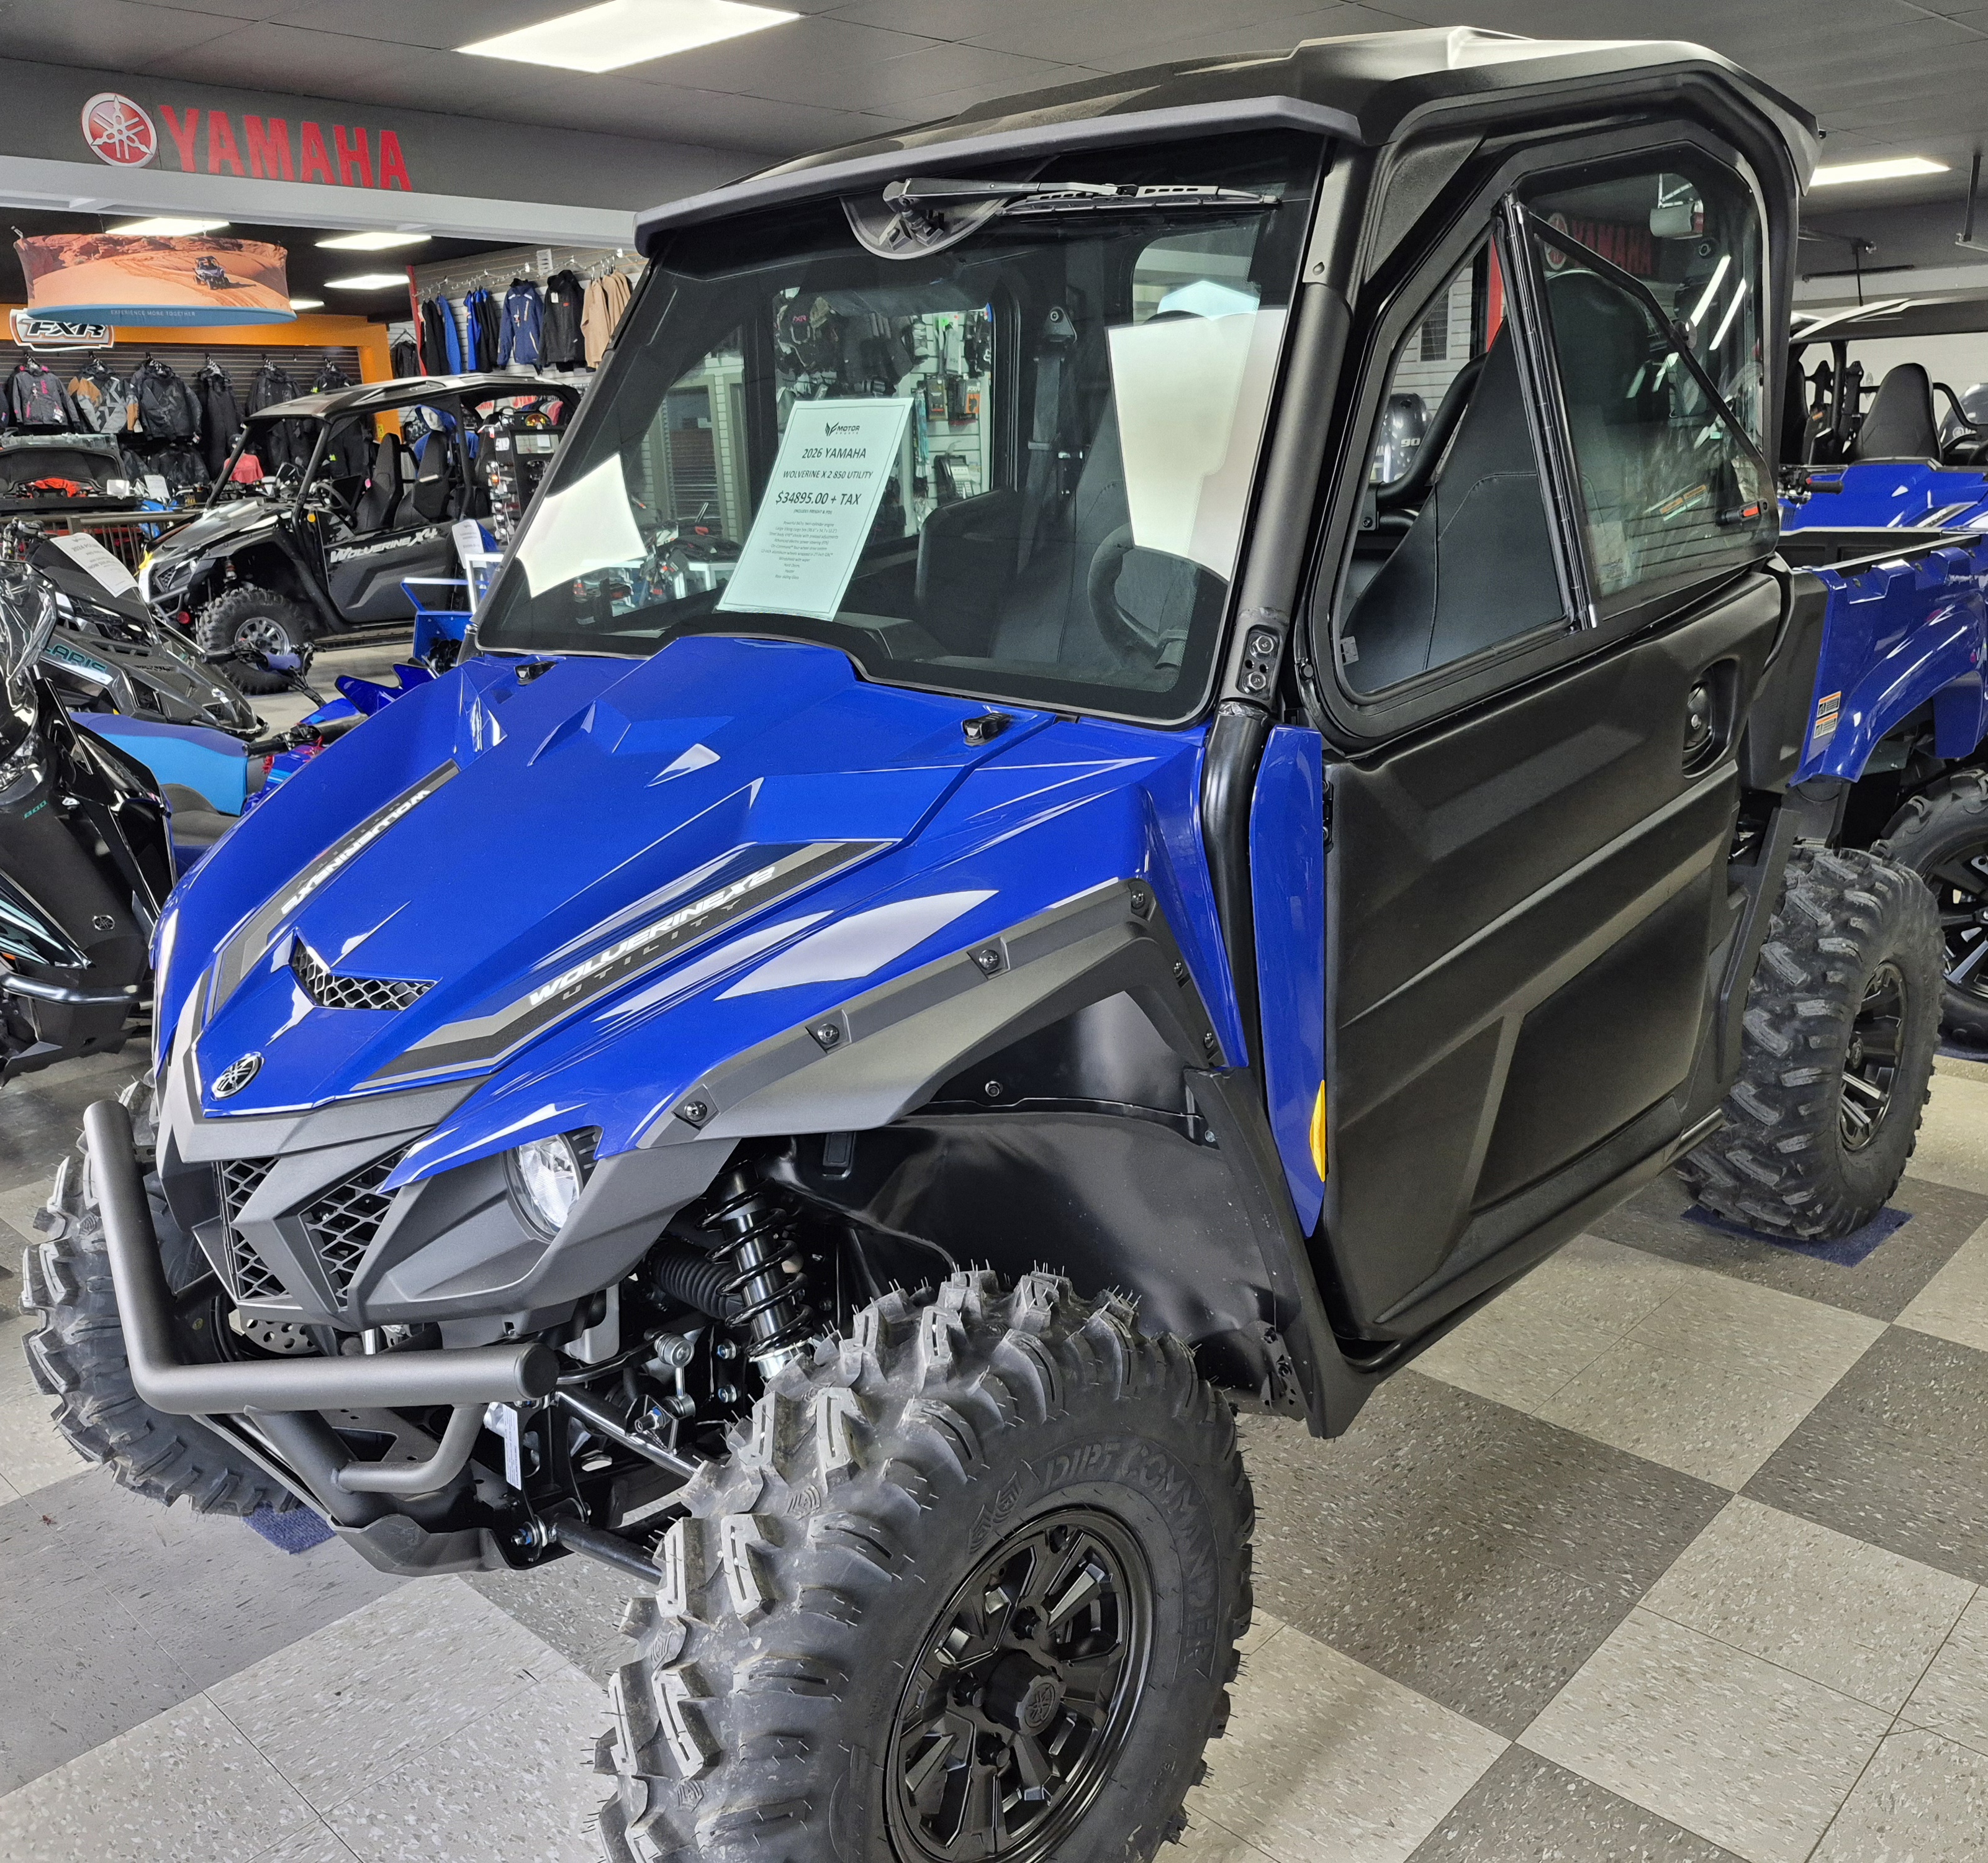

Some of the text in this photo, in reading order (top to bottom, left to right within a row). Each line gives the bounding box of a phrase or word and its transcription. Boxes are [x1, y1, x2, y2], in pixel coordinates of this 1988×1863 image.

[159, 104, 412, 191] YAMAHA
[20, 319, 106, 338] FXR
[1400, 437, 1421, 447] 90
[802, 448, 866, 458] 2026 YAMAHA
[783, 470, 820, 478] WOLVERINE
[827, 471, 833, 479] 2
[833, 471, 846, 479] 850
[775, 491, 862, 505] $34895.00 + TAX
[44, 643, 108, 674] ARIS
[24, 799, 47, 819] 800
[561, 899, 742, 1000] UTILITY
[1041, 1442, 1121, 1490] DIRT
